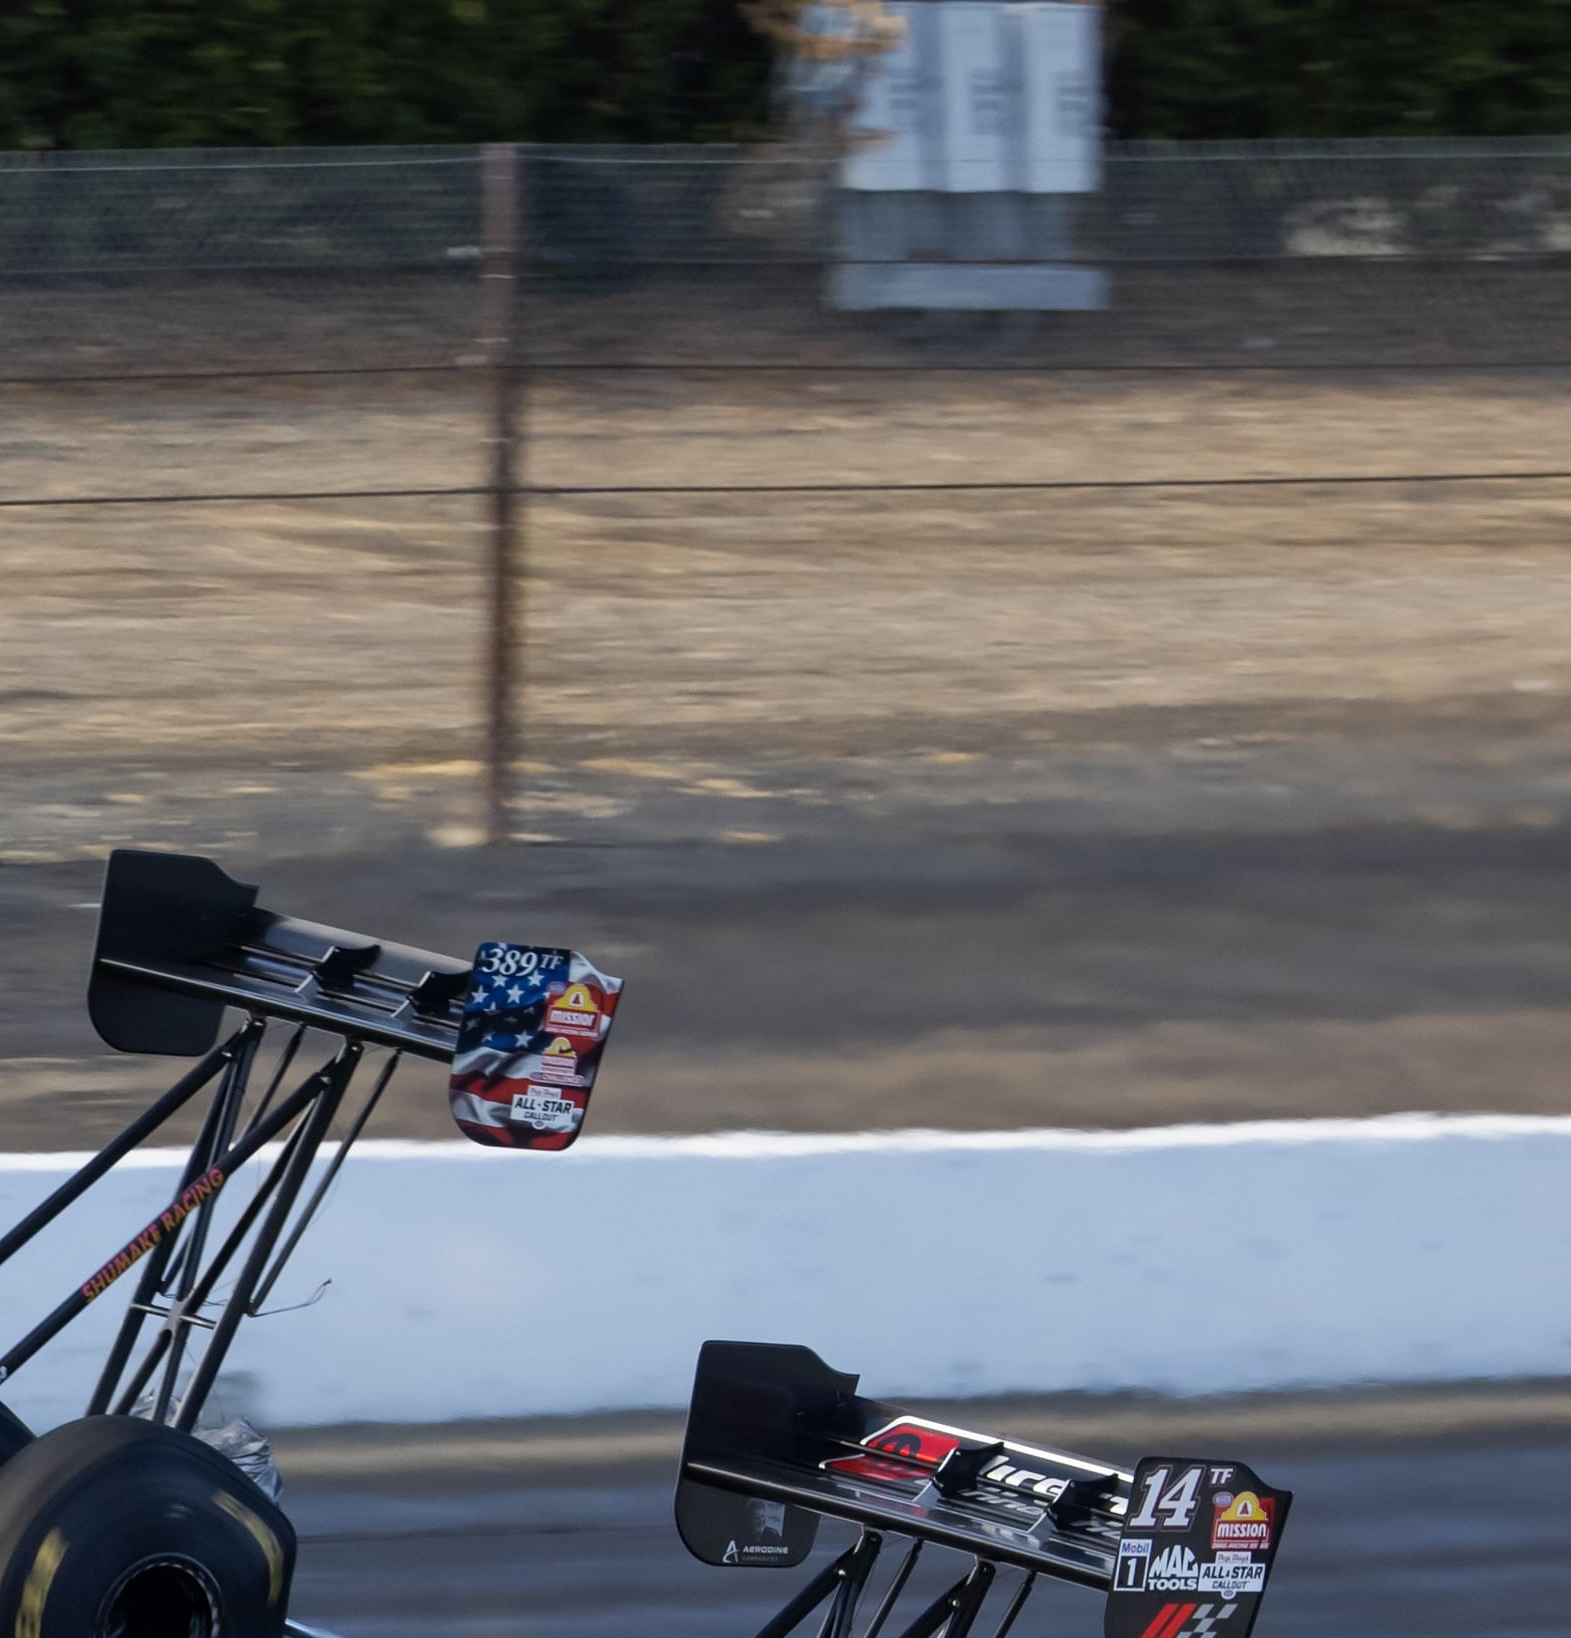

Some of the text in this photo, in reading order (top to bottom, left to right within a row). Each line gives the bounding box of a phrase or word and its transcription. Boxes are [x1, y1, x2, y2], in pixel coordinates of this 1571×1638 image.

[481, 948, 565, 976] 389 TF
[82, 1167, 225, 1303] SHUMAKE RACING
[1127, 1466, 1234, 1529] 14 TF
[1122, 1542, 1149, 1554] Mobil
[1148, 1545, 1198, 1577] MAC
[1127, 1558, 1137, 1586] 1
[1148, 1578, 1197, 1591] TOOLS
[1212, 1580, 1249, 1590] CALLOUT
